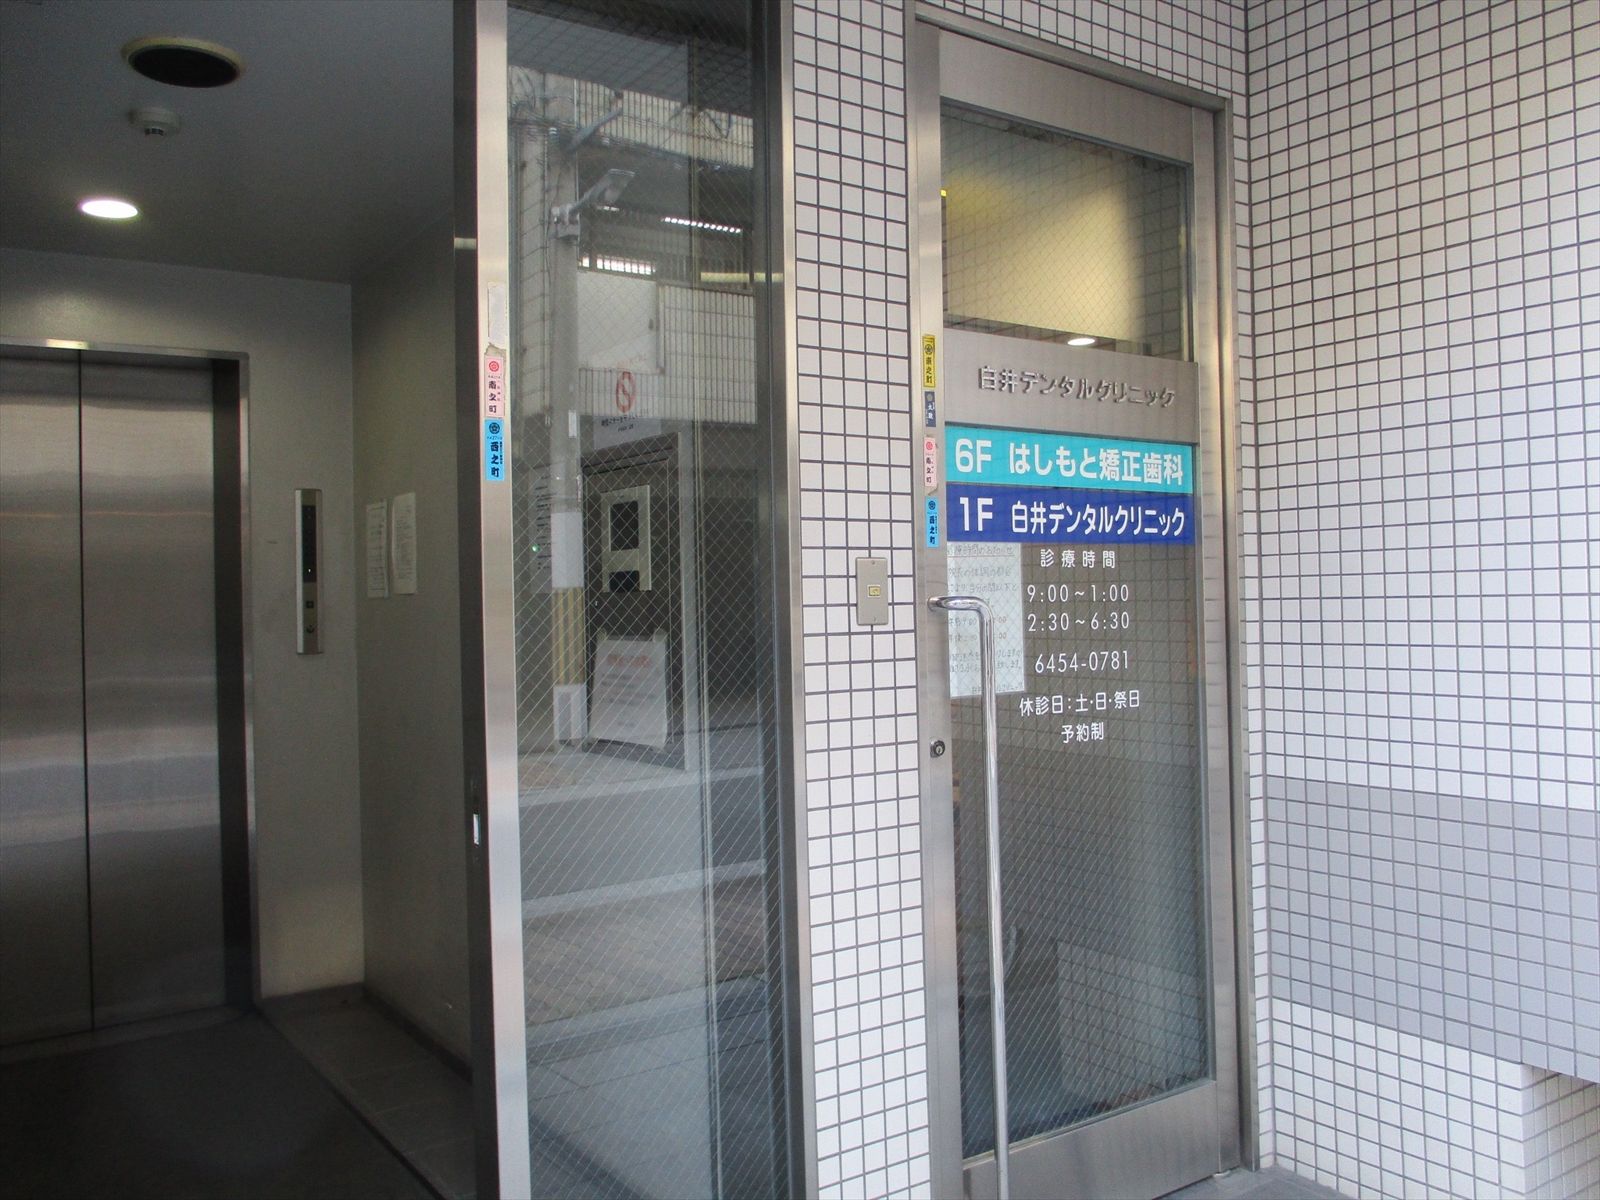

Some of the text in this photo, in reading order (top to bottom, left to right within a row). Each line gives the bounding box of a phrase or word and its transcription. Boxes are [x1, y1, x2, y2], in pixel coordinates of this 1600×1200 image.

[978, 366, 1176, 407] 白井デンタルクリニック
[955, 438, 1184, 485] 6F はしもと矯正歯科
[960, 497, 993, 532] 1F
[1011, 500, 1185, 536] 白井デンタルクリニック
[1040, 549, 1116, 569] 診療時間
[1035, 651, 1129, 674] 6454-0781
[1061, 722, 1104, 744] 予約制
